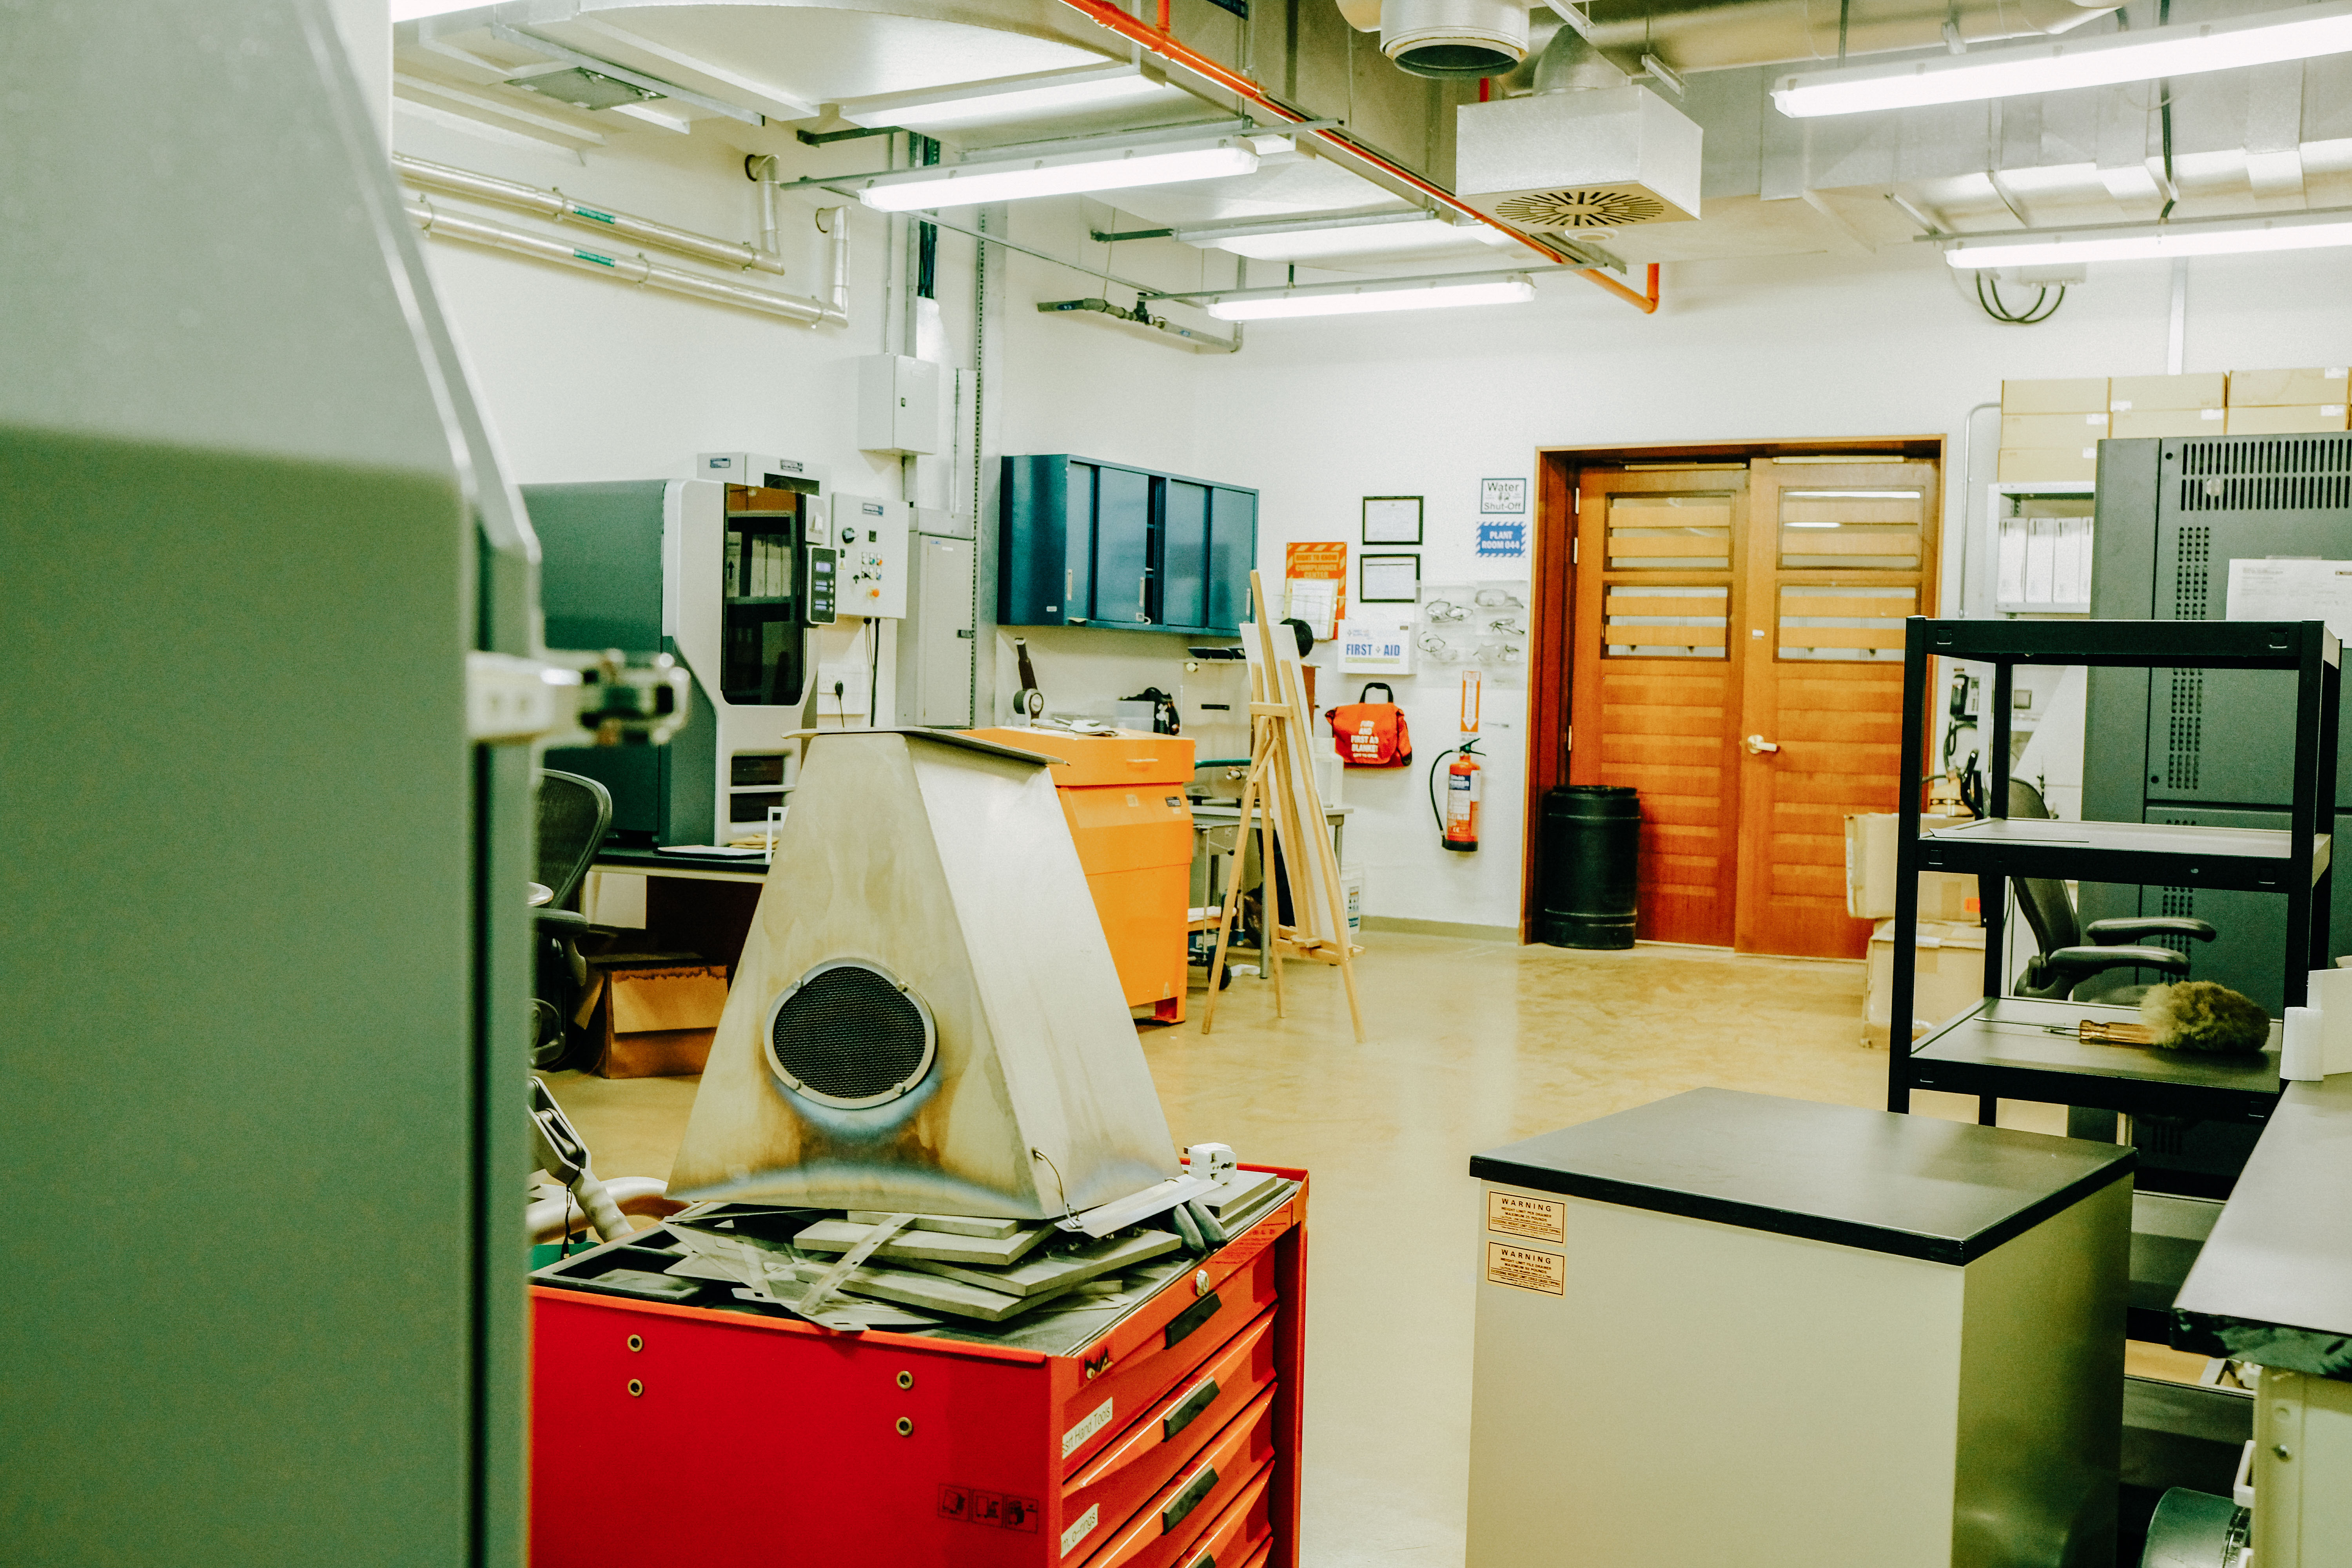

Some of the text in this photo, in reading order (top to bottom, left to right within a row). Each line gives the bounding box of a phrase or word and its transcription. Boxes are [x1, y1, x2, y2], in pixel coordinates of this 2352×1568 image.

[1488, 483, 1519, 492] Water
[1490, 531, 1513, 539] PLANT
[1505, 541, 1520, 549] 044
[1346, 644, 1400, 656] FIRST AID
[1502, 1198, 1551, 1212] WARNING
[1501, 1249, 1551, 1264] WARNING
[1075, 1417, 1092, 1443] Hand
[1094, 1405, 1111, 1427] Tools
